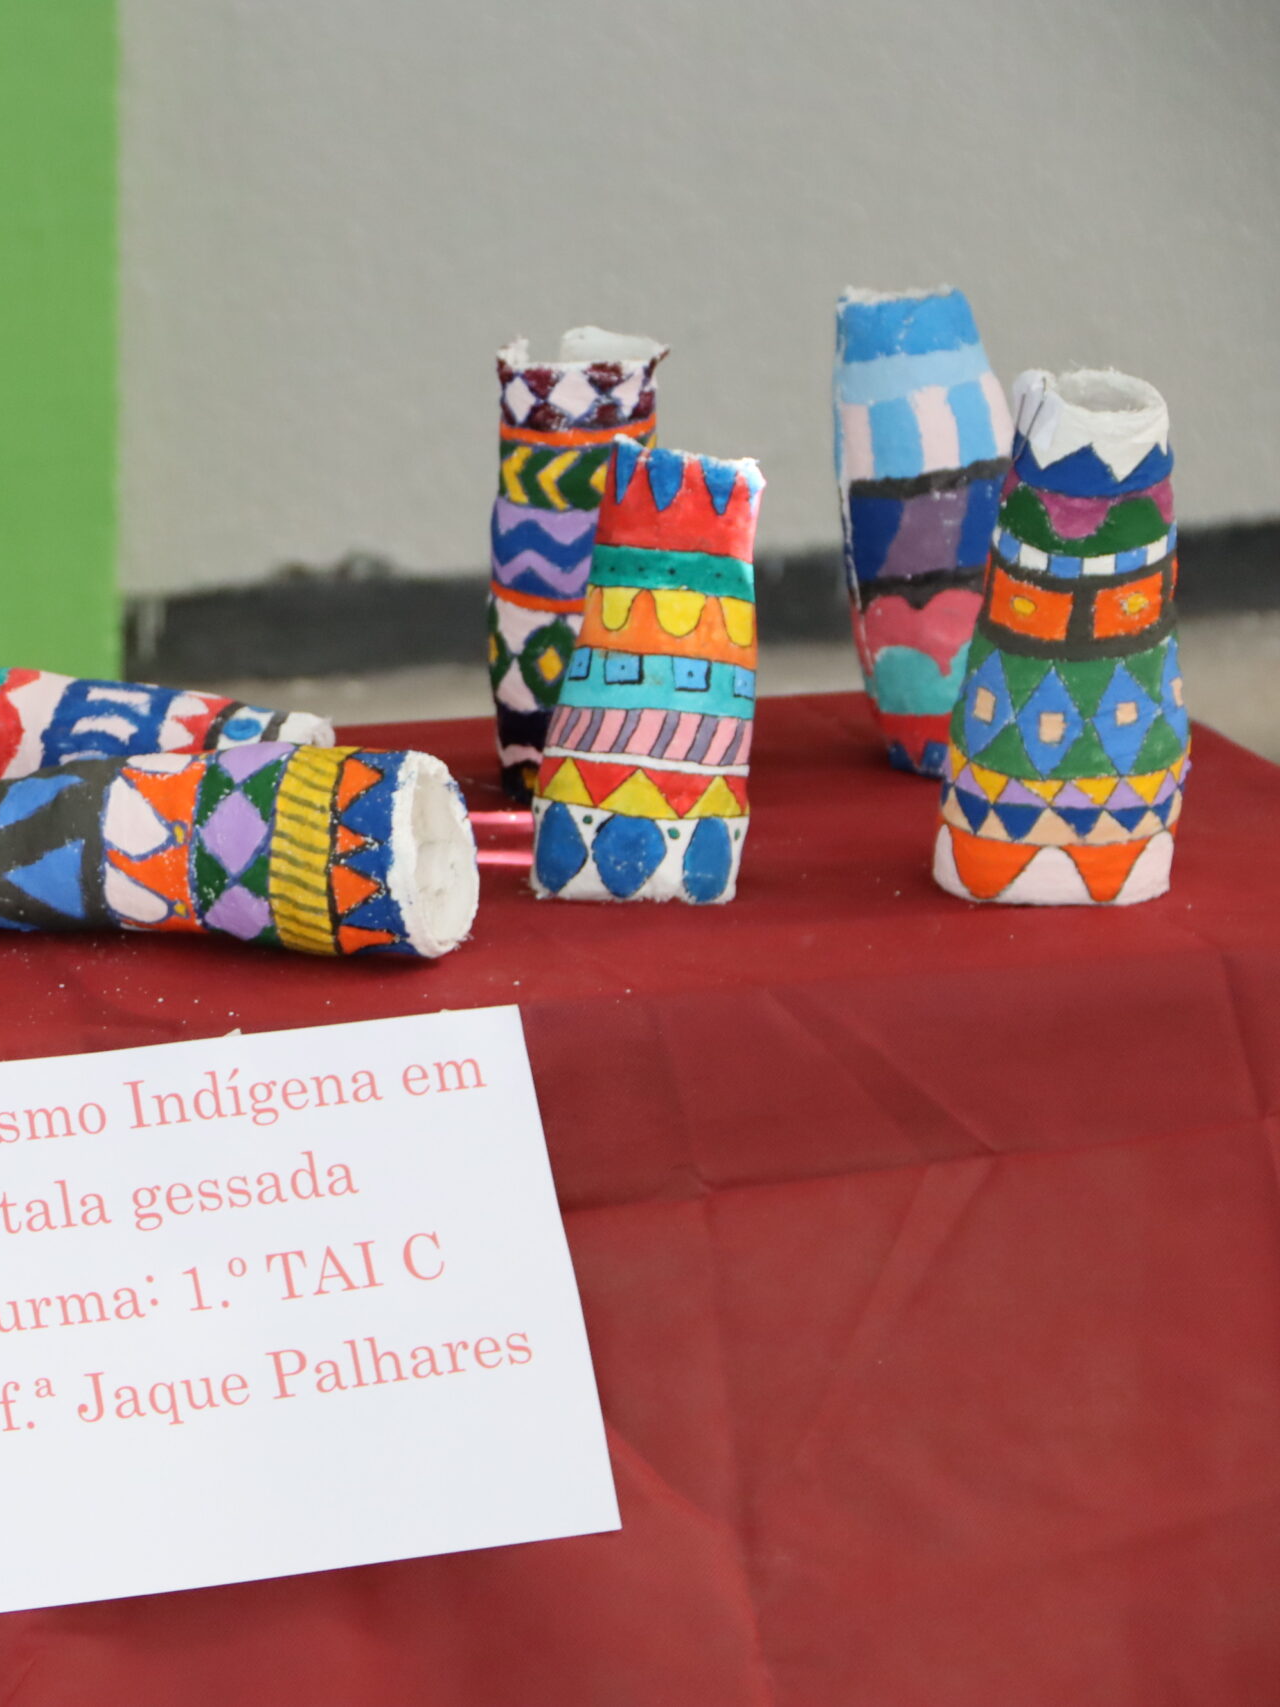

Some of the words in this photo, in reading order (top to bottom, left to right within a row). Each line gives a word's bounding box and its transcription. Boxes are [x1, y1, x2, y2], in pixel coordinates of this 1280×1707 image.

[123, 1067, 383, 1129] Indígena
[401, 1057, 487, 1096] em
[132, 1150, 359, 1232] gessada
[265, 1240, 383, 1301] TAI
[402, 1231, 446, 1281] C
[77, 1371, 250, 1426] Jaque
[266, 1332, 533, 1399] Palhares
